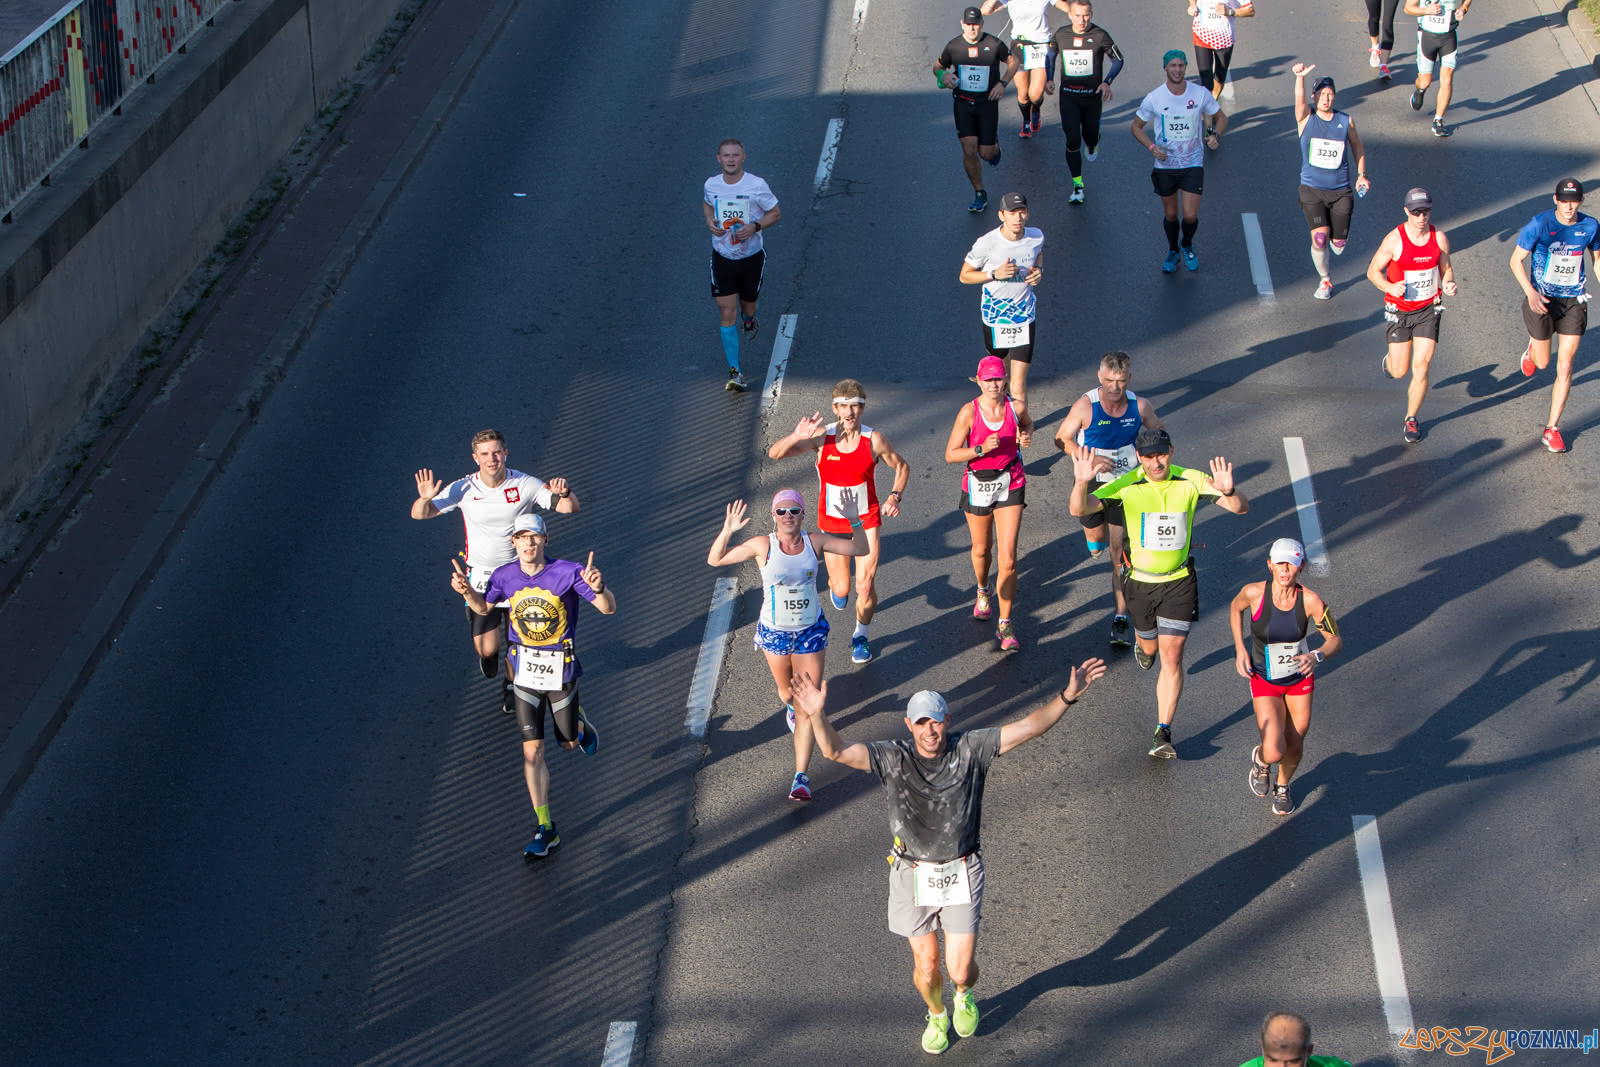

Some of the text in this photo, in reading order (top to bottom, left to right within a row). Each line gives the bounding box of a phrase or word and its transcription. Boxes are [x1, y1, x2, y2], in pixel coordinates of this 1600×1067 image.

[1169, 123, 1190, 131] 3234
[1317, 149, 1338, 158] 3230
[722, 210, 744, 218] 5202
[1554, 265, 1576, 275] 3283
[1115, 457, 1129, 469] 88
[978, 482, 1003, 493] 2872
[1157, 526, 1176, 536] 561
[784, 599, 810, 610] 1559
[526, 662, 554, 675] 3794
[928, 873, 959, 889] 5892
